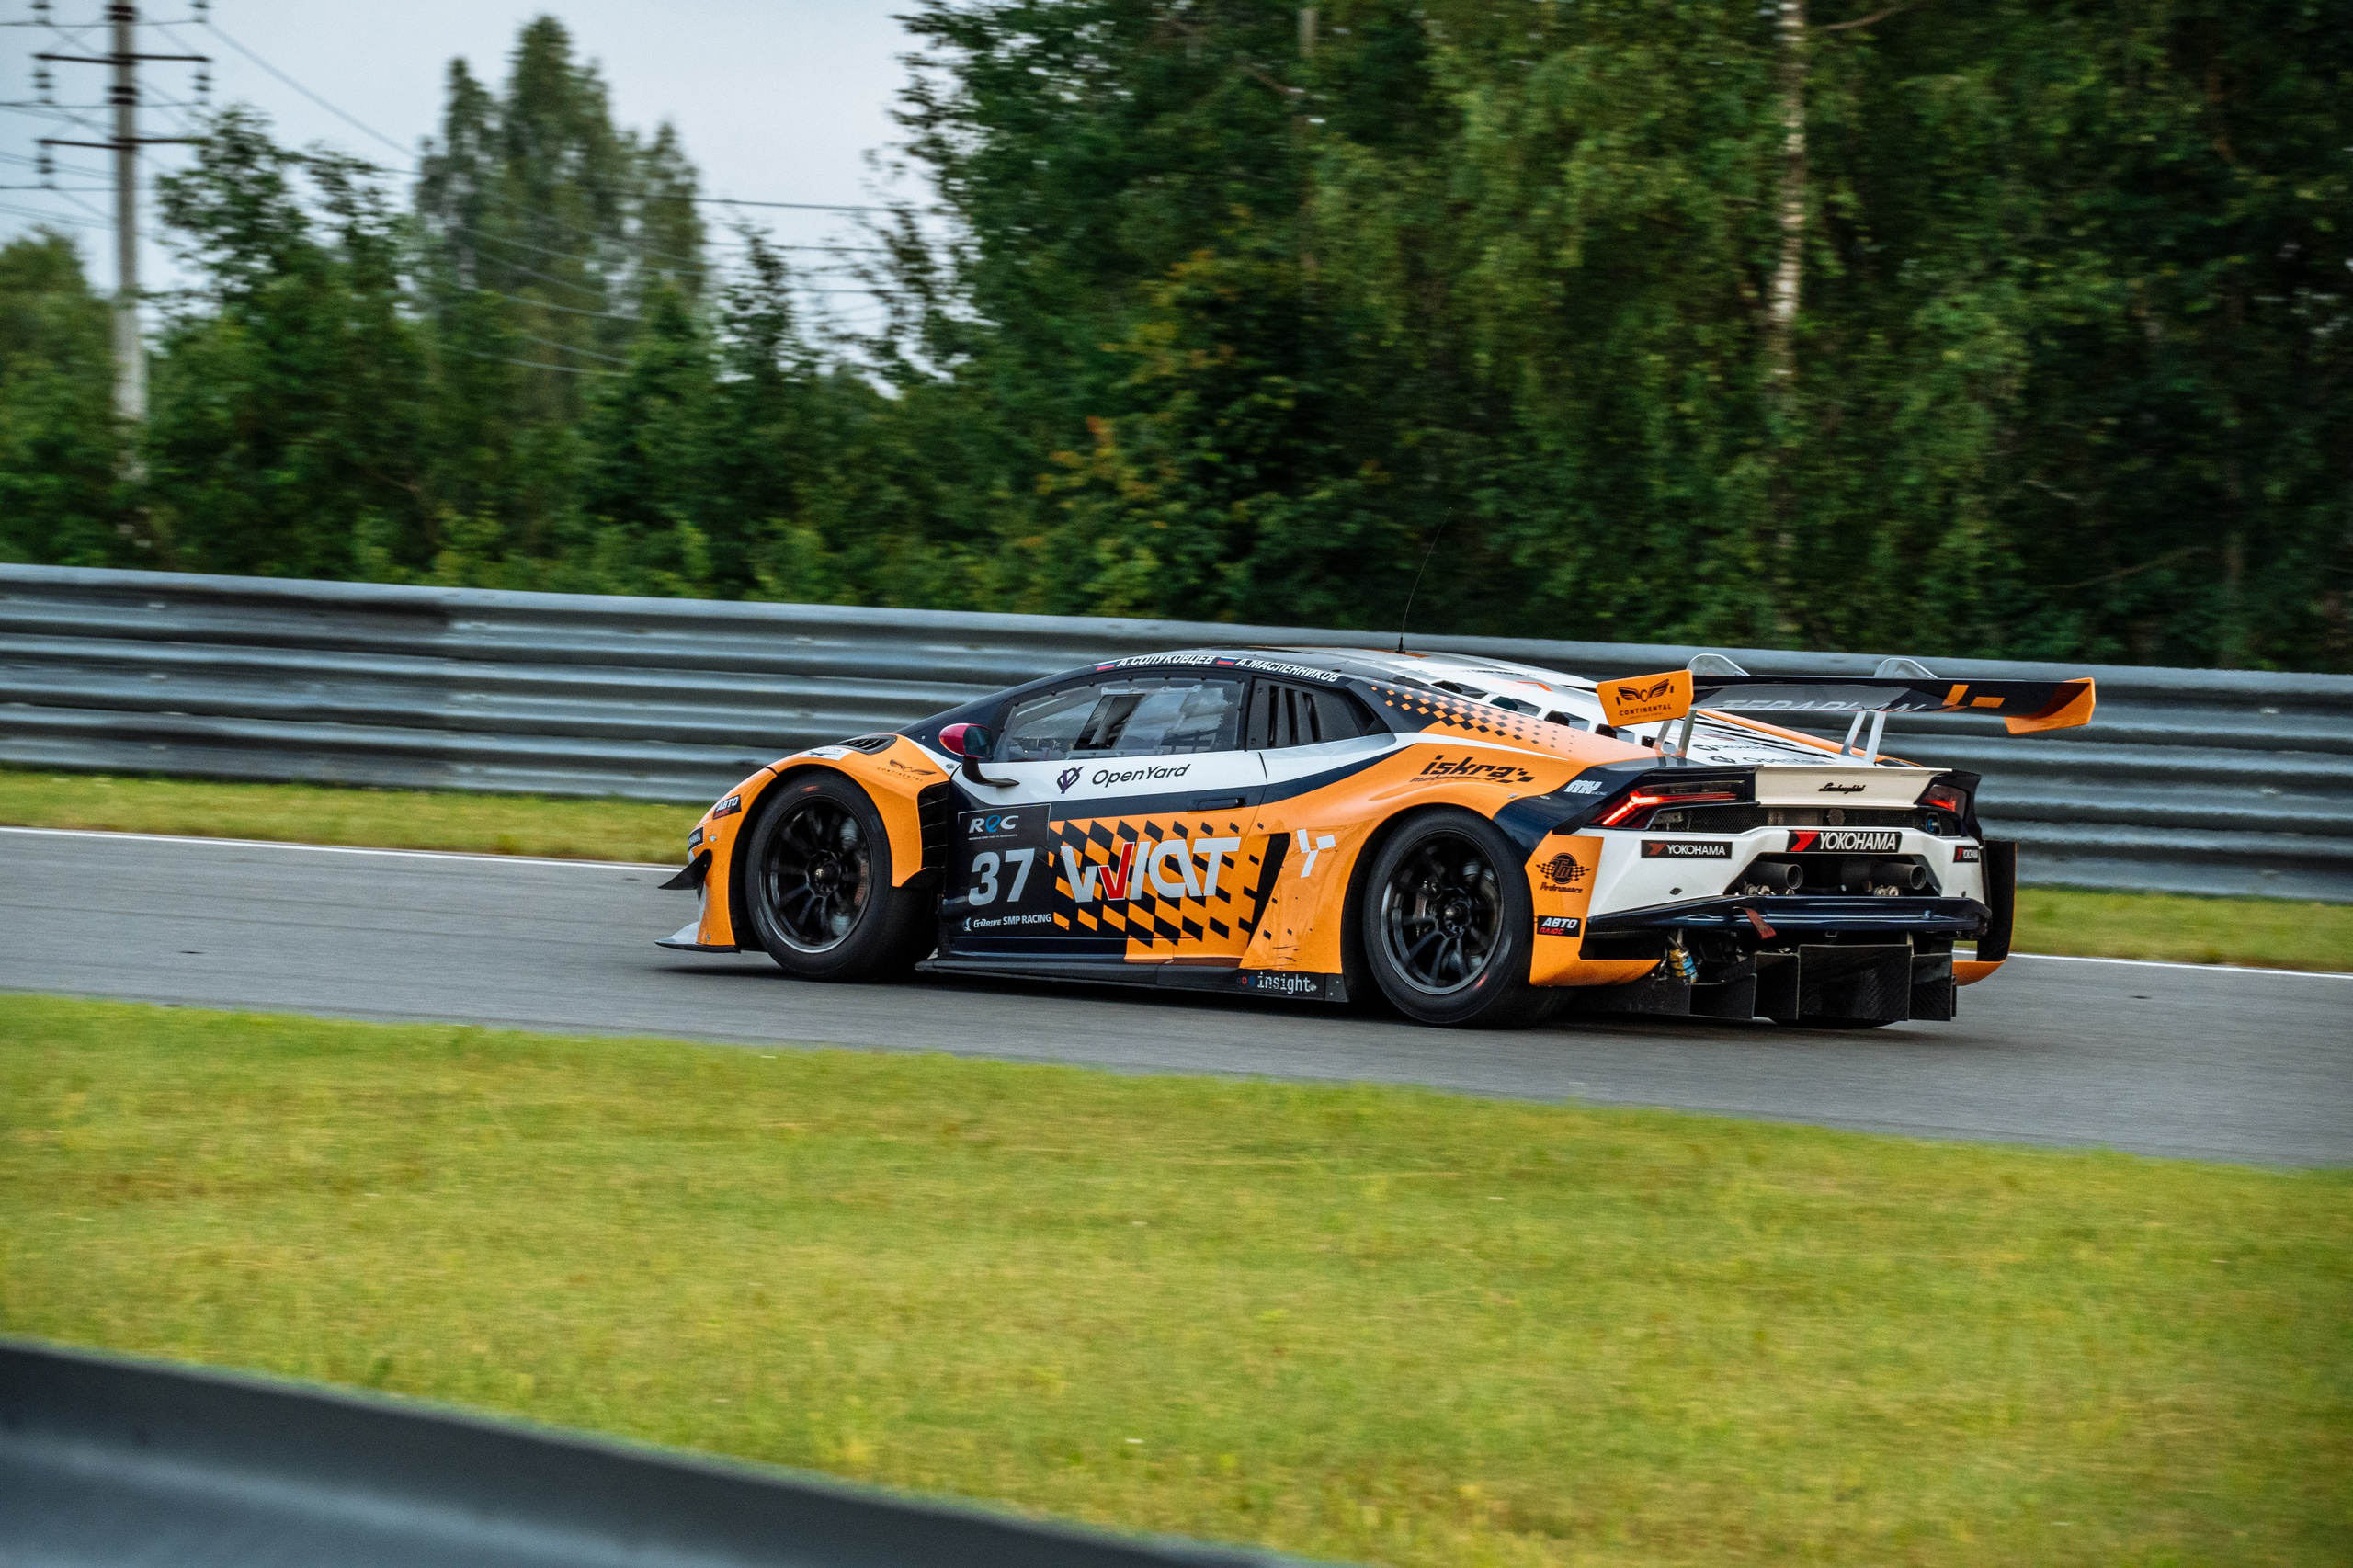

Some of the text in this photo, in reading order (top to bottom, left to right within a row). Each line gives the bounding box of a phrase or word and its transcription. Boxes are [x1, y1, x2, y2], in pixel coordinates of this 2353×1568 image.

[1235, 658, 1342, 682] А.МАСЛЕННИКОВ
[1620, 704, 1672, 716] CONTINENTAL
[1420, 755, 1518, 778] iskra
[1092, 764, 1191, 788] OpenYard
[716, 796, 739, 812] АВТО
[1666, 844, 1726, 856] YOKOHAMA
[1820, 832, 1896, 850] YOKOHAMA
[968, 847, 1035, 906] 37
[1003, 915, 1021, 926] SMP
[1021, 914, 1051, 925] RACING
[1541, 917, 1578, 929] АВТО
[1257, 971, 1311, 994] insight
